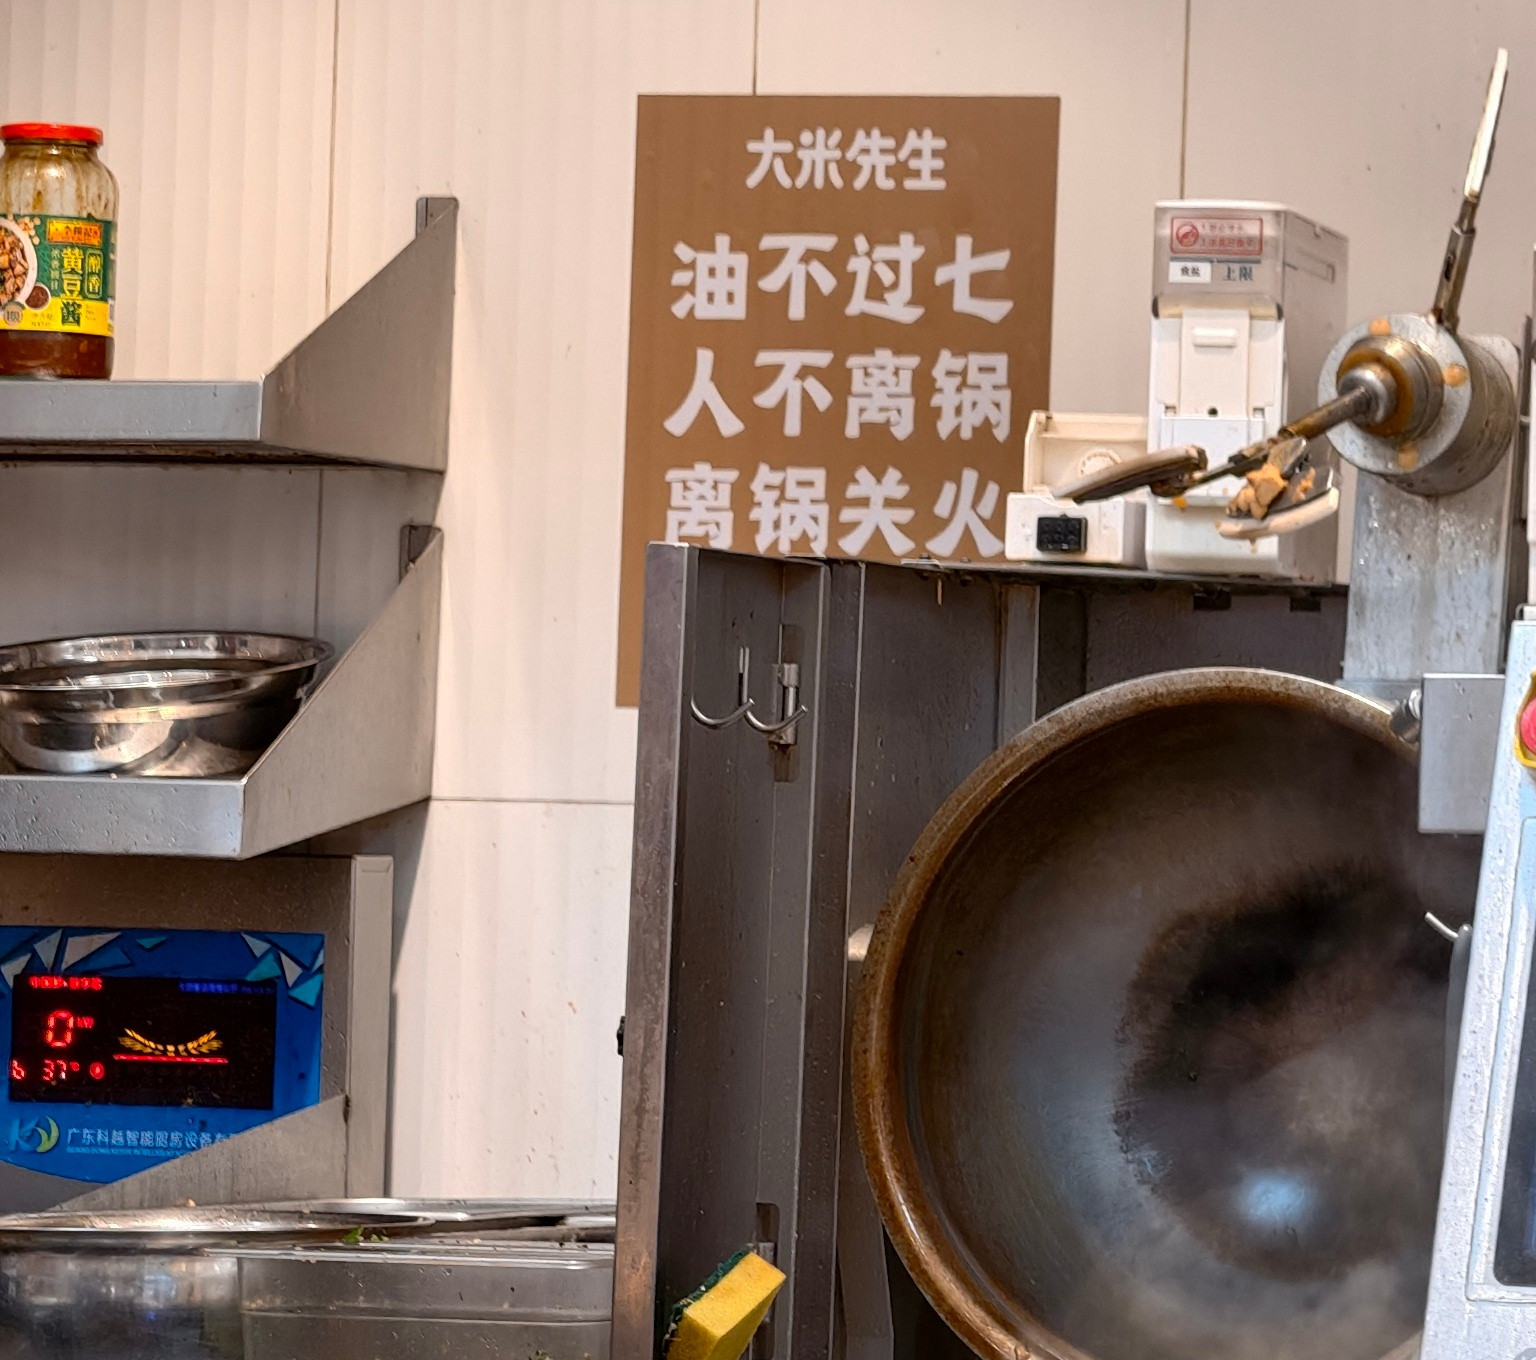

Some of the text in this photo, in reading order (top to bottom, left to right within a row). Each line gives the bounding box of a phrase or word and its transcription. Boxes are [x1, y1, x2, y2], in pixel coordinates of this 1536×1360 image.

[746, 127, 948, 190] 大米先生
[670, 233, 1014, 324] 油不过七
[663, 347, 1012, 443] 人不离锅
[665, 462, 1004, 557] 离锅关火
